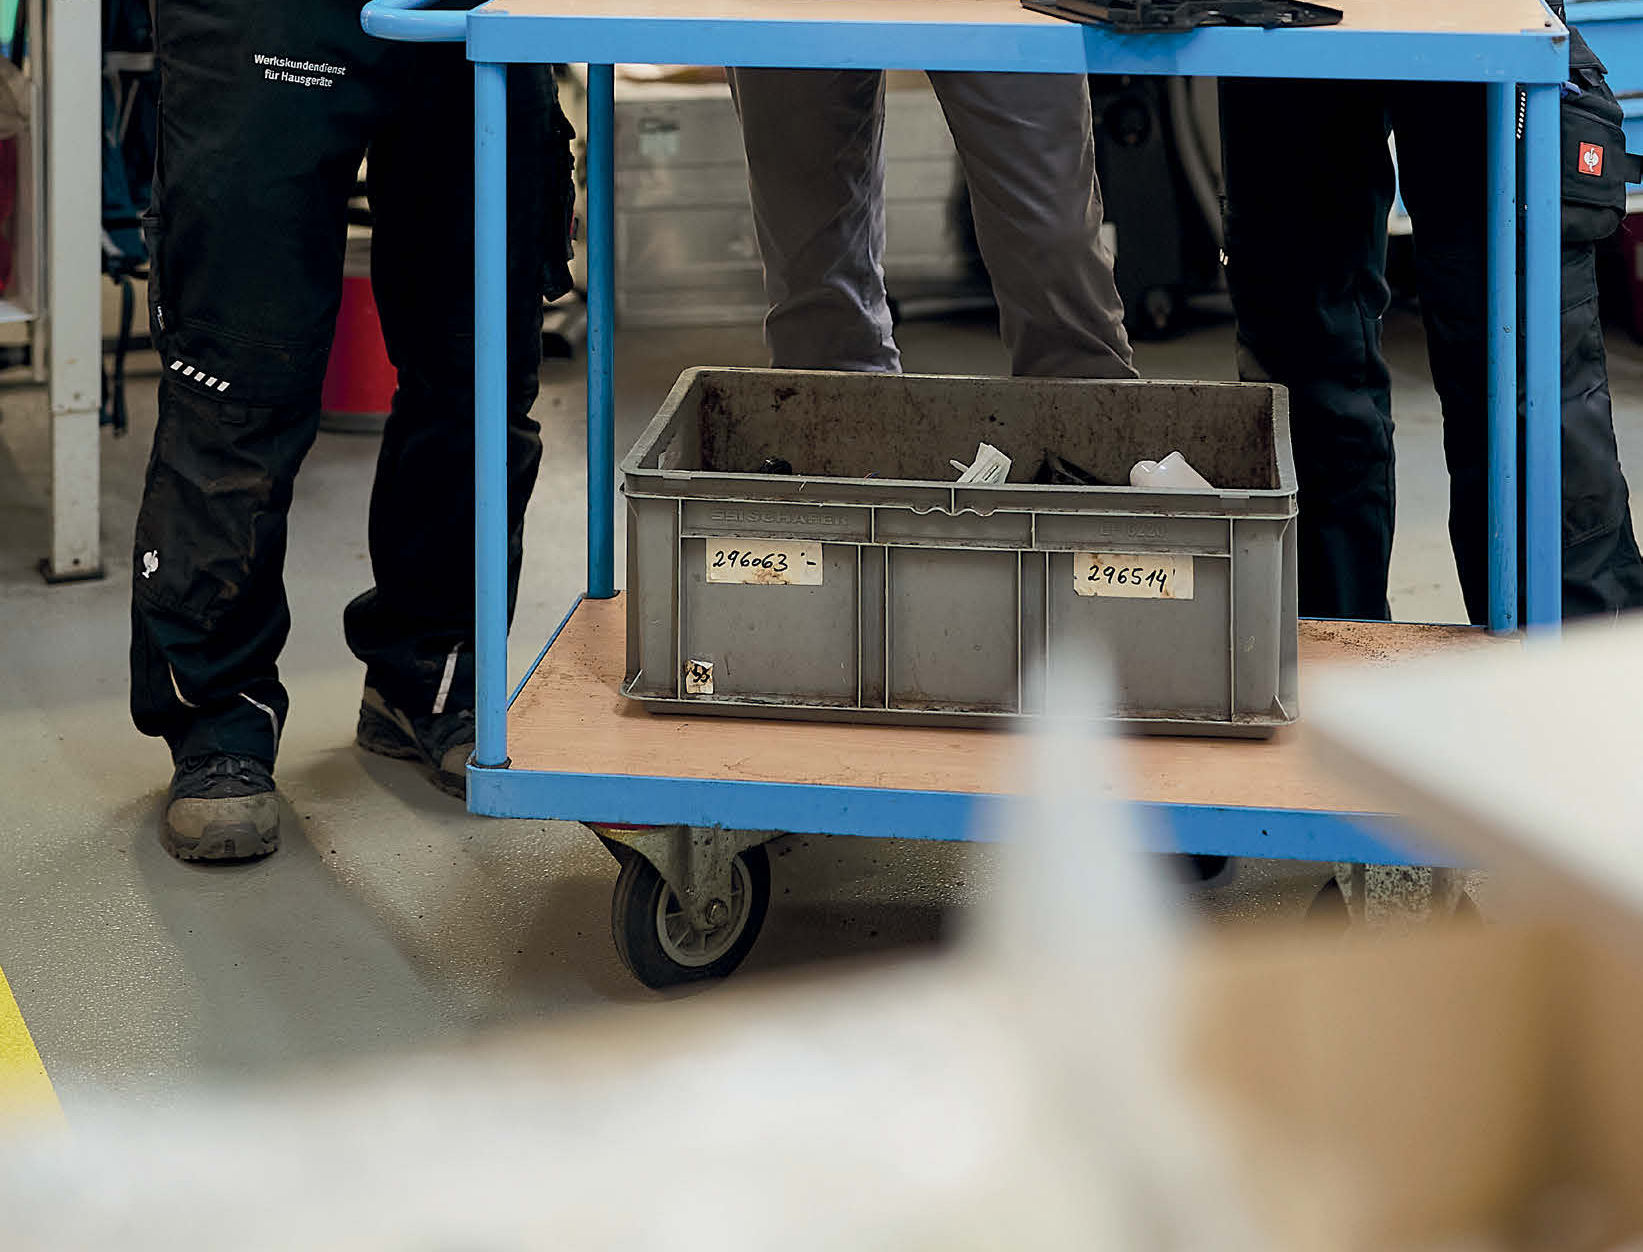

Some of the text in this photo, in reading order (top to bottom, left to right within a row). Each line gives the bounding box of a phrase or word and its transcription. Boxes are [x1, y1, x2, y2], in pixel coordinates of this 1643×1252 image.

[254, 54, 346, 75] Werkskundendienst
[264, 69, 333, 87] für Hausgeräte
[712, 550, 788, 572] 296063
[1088, 565, 1167, 593] 296514
